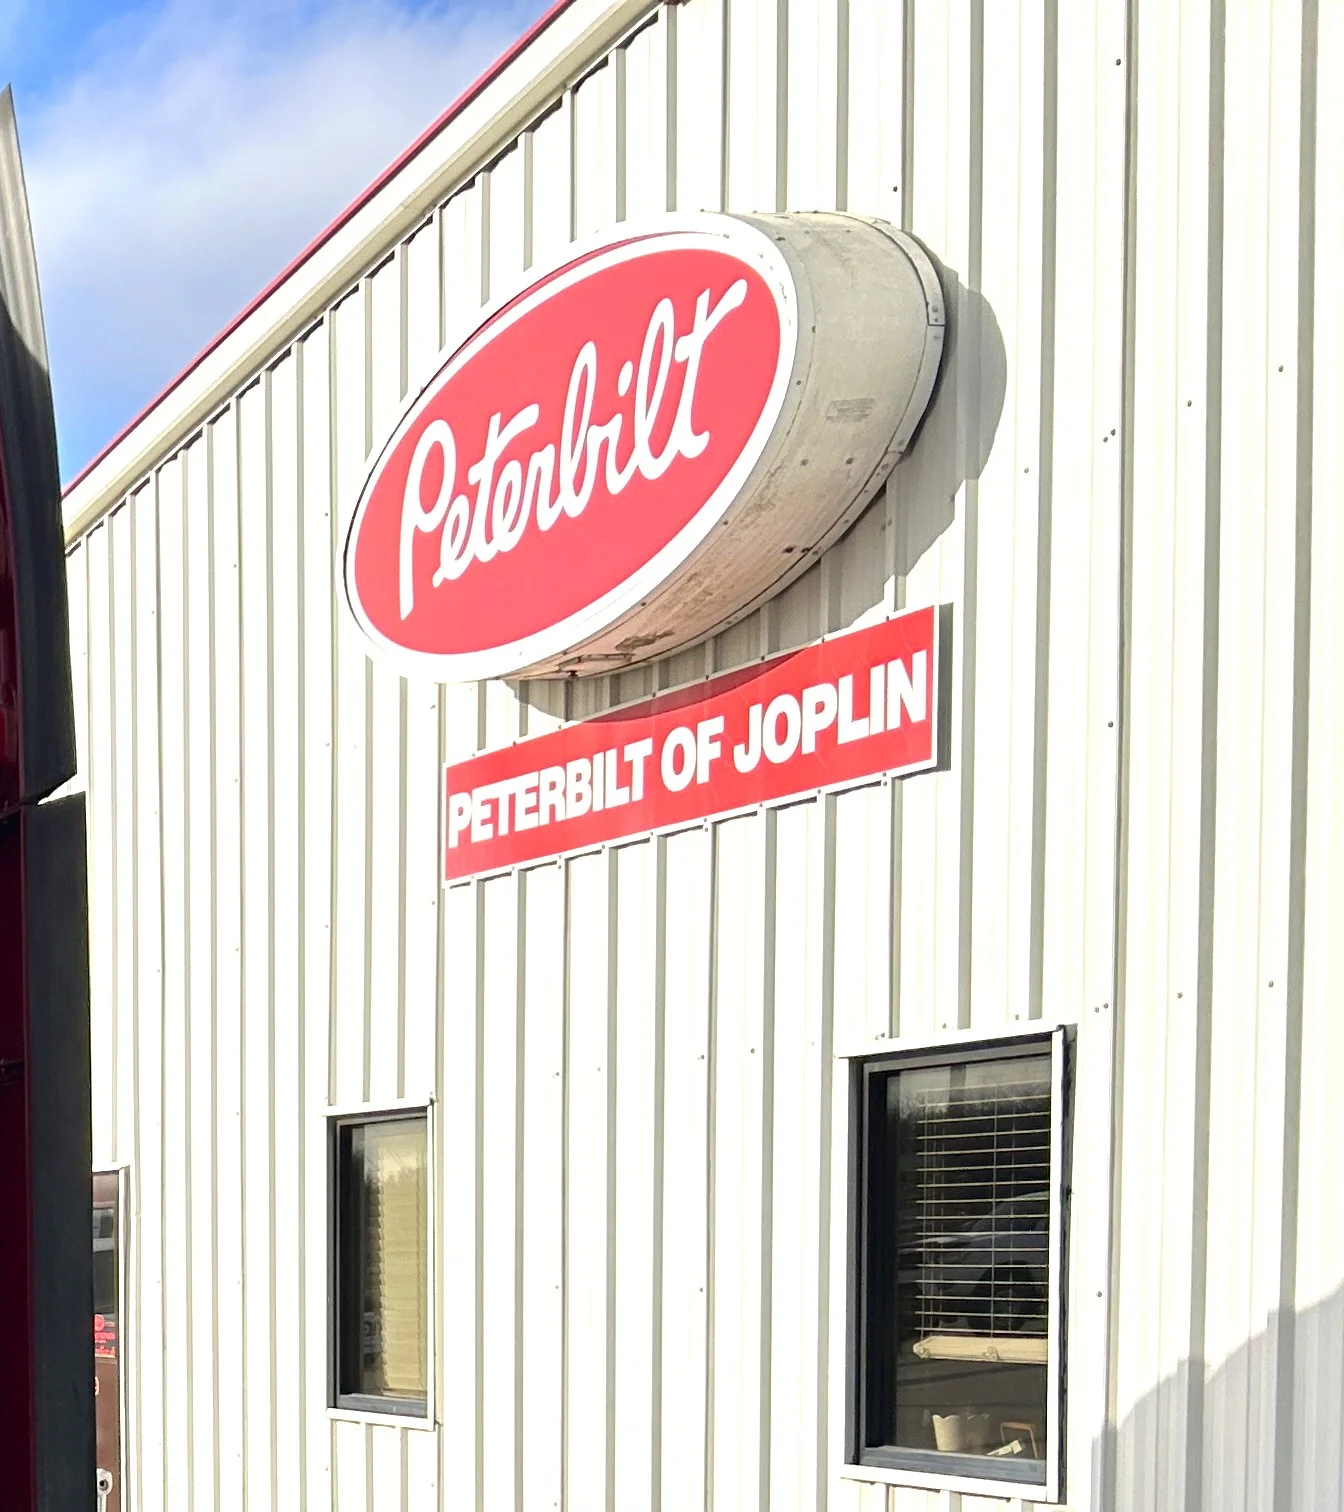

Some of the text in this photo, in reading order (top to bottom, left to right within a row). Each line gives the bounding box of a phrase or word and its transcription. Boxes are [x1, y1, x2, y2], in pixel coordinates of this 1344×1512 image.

[400, 279, 749, 621] Peterbilt
[448, 648, 928, 849] PETERBILT OF JOPLIN
